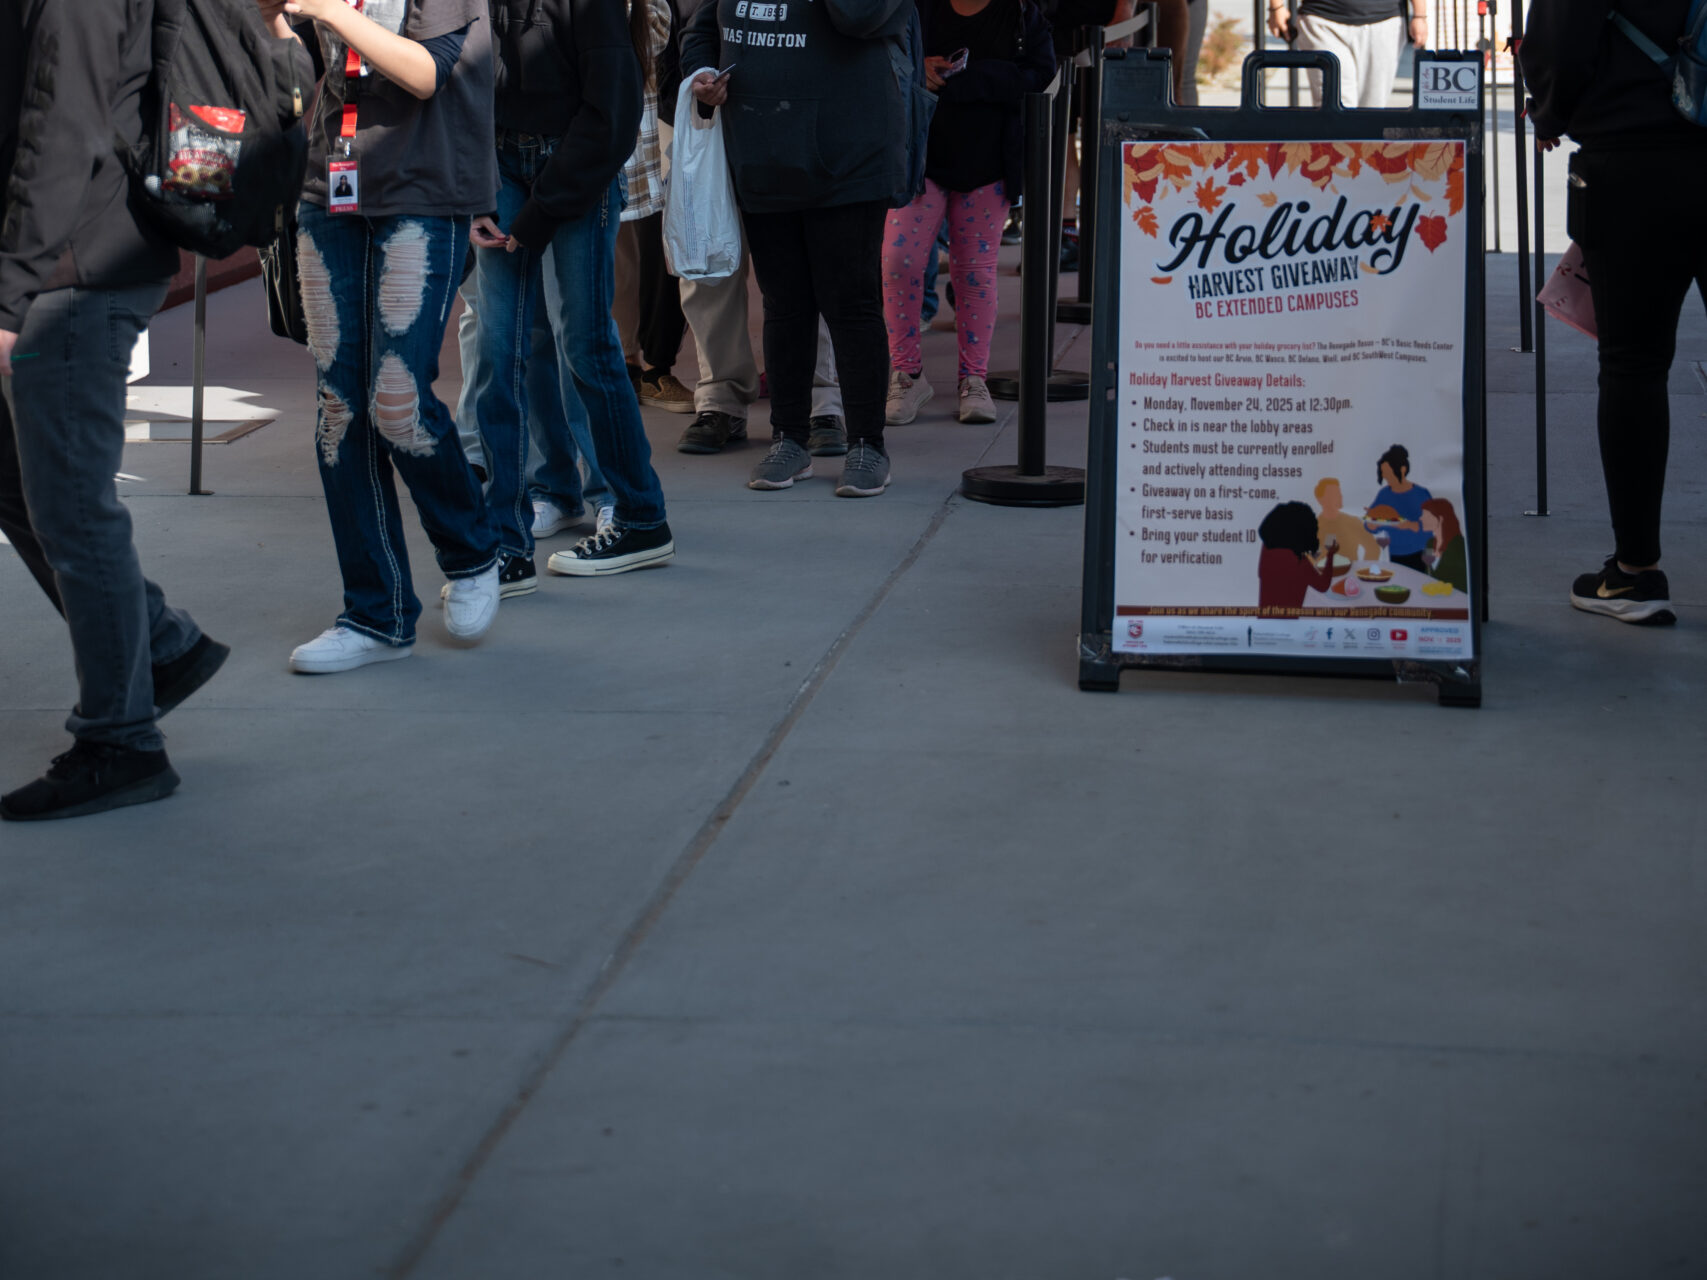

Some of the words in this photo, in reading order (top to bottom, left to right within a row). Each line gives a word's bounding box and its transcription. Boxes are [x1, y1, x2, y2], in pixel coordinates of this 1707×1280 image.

[739, 4, 759, 17] ET.
[1430, 66, 1477, 92] BC
[1423, 95, 1457, 104] Student
[1458, 95, 1476, 104] Life
[1156, 195, 1421, 276] Holiday
[1188, 267, 1264, 300] HARVEST
[1271, 255, 1360, 290] GIVEAWAY
[1195, 300, 1213, 320] BC
[1217, 294, 1284, 317] EXTENDED
[1287, 289, 1360, 313] CAMPUSES
[1224, 341, 1237, 350] with
[1238, 343, 1252, 352] your
[1253, 341, 1275, 352] holiday
[1129, 372, 1167, 389] Holiday
[1171, 372, 1212, 387] Harvest
[1214, 373, 1263, 390] Giveaway
[1266, 373, 1306, 388] Details:
[1144, 397, 1187, 413] Monday,
[1190, 397, 1243, 412] November
[1266, 398, 1293, 412] 2025
[1296, 399, 1306, 412] at
[1143, 418, 1175, 433] Check
[1178, 418, 1188, 432] in
[1190, 419, 1200, 432] is
[1202, 421, 1228, 433] near
[1230, 419, 1248, 433] the
[1250, 420, 1280, 436] lobby
[1282, 423, 1313, 434] areas
[1142, 440, 1190, 454] Students
[1192, 441, 1219, 455] must
[1221, 441, 1234, 455] be
[1237, 441, 1289, 458] currently
[1291, 440, 1334, 455] enrolled
[1142, 462, 1162, 476] and
[1164, 463, 1206, 479] actively
[1208, 463, 1260, 480] attending
[1262, 464, 1303, 478] classes
[1142, 483, 1191, 500] Giveaway
[1193, 487, 1207, 498] on
[1209, 487, 1216, 498] a
[1218, 485, 1280, 500] first-come,
[1141, 506, 1202, 520] first-serve
[1205, 507, 1234, 521] basis
[1141, 527, 1171, 544] Bring
[1173, 531, 1200, 545] your
[1202, 529, 1243, 543] student
[1246, 529, 1257, 542] ID
[1141, 550, 1158, 564] for
[1160, 551, 1222, 565] verification
